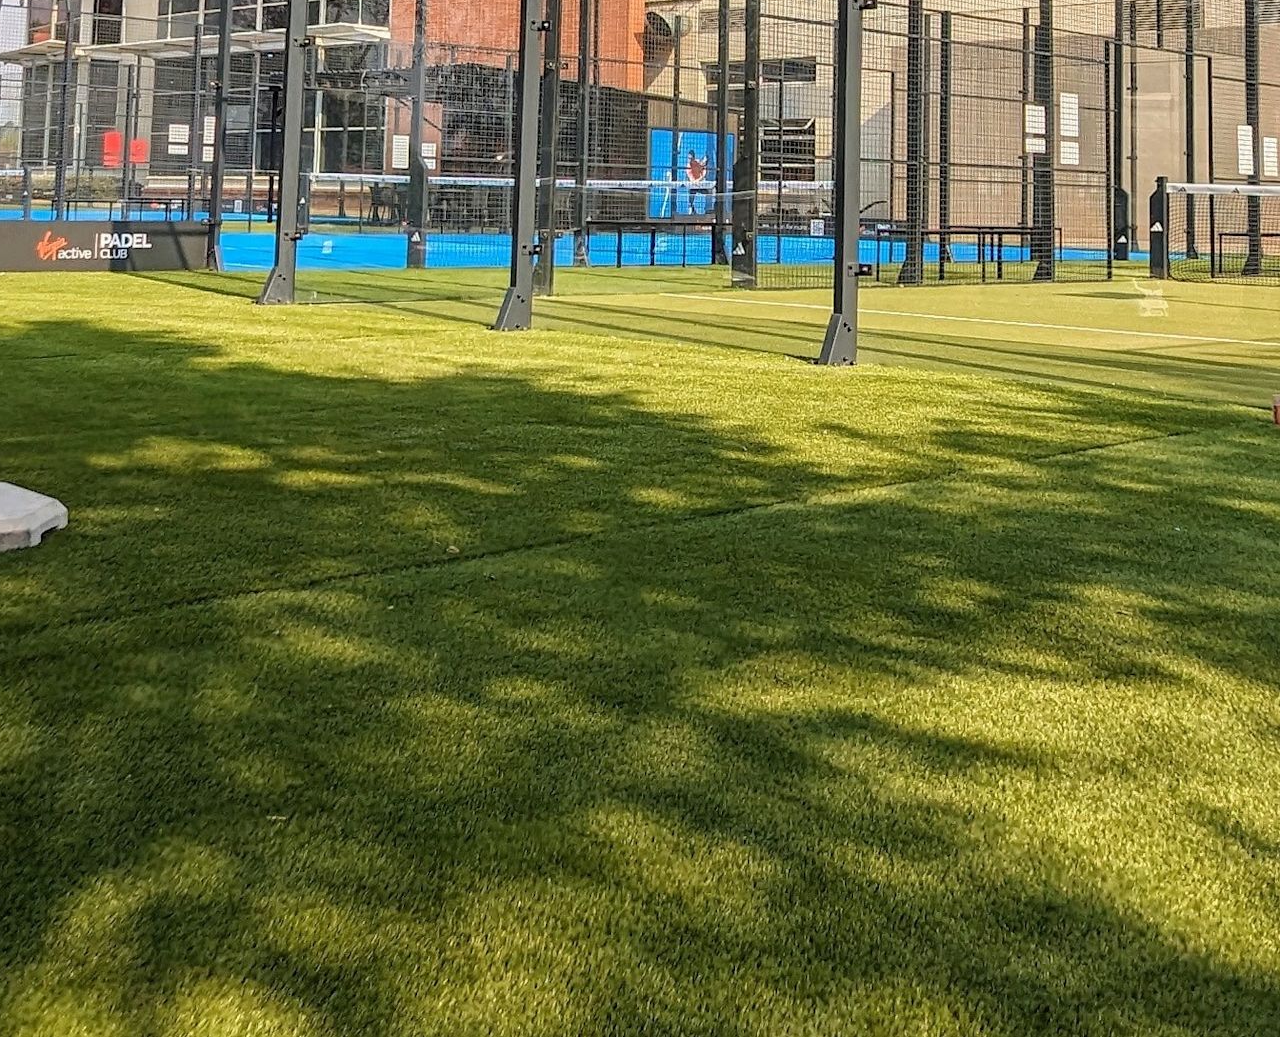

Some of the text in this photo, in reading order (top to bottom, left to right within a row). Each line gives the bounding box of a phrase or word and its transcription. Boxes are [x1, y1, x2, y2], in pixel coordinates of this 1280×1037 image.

[100, 233, 152, 249] PADEL
[58, 247, 92, 259] active
[100, 248, 128, 259] CLUB
